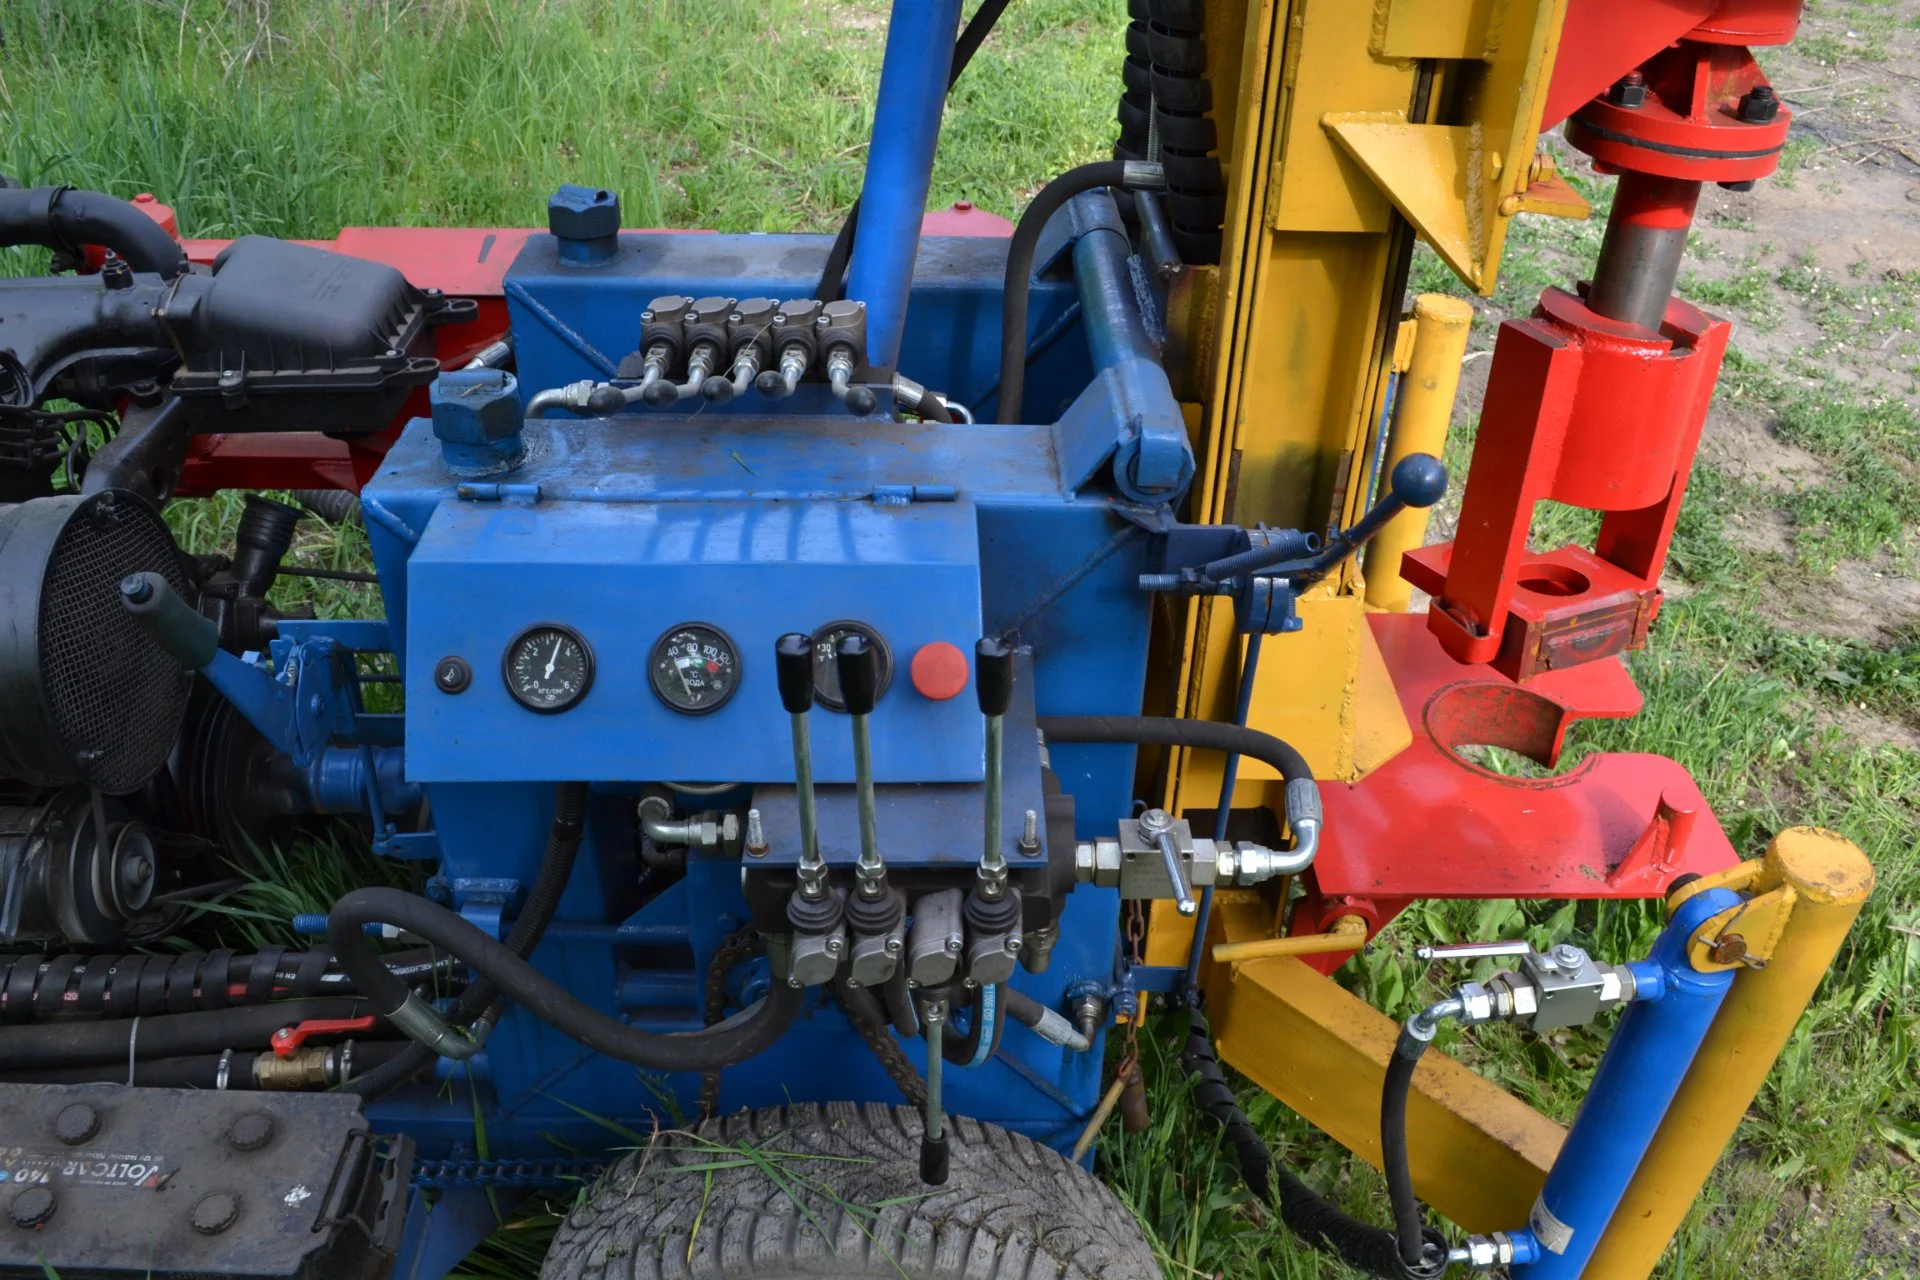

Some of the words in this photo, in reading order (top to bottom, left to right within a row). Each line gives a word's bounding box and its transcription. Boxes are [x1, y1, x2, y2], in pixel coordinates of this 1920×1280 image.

[532, 647, 539, 656] 2
[565, 647, 571, 656] 4
[667, 646, 679, 657] 40
[686, 643, 698, 652] 80
[703, 645, 718, 657] 100
[533, 680, 539, 689] 0
[564, 681, 570, 689] 6
[62, 1161, 158, 1187] VOLTCAR
